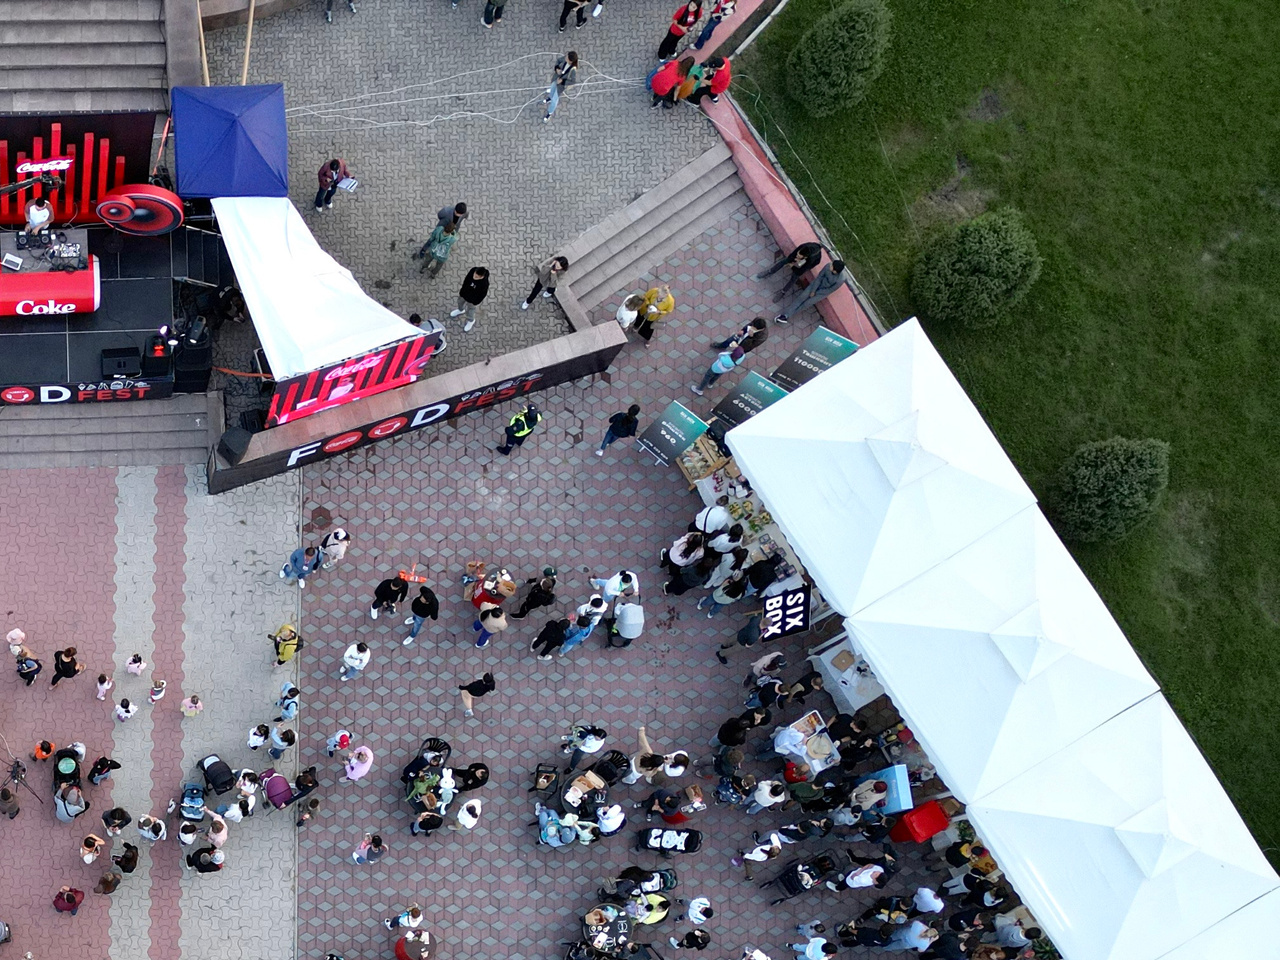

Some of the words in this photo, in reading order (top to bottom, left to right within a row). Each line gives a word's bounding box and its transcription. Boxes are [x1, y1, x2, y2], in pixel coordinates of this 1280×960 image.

[16, 299, 77, 315] Coke
[77, 387, 151, 402] FEST
[453, 378, 545, 414] FEST
[764, 595, 784, 639] BOX
[785, 592, 805, 631] SIX
